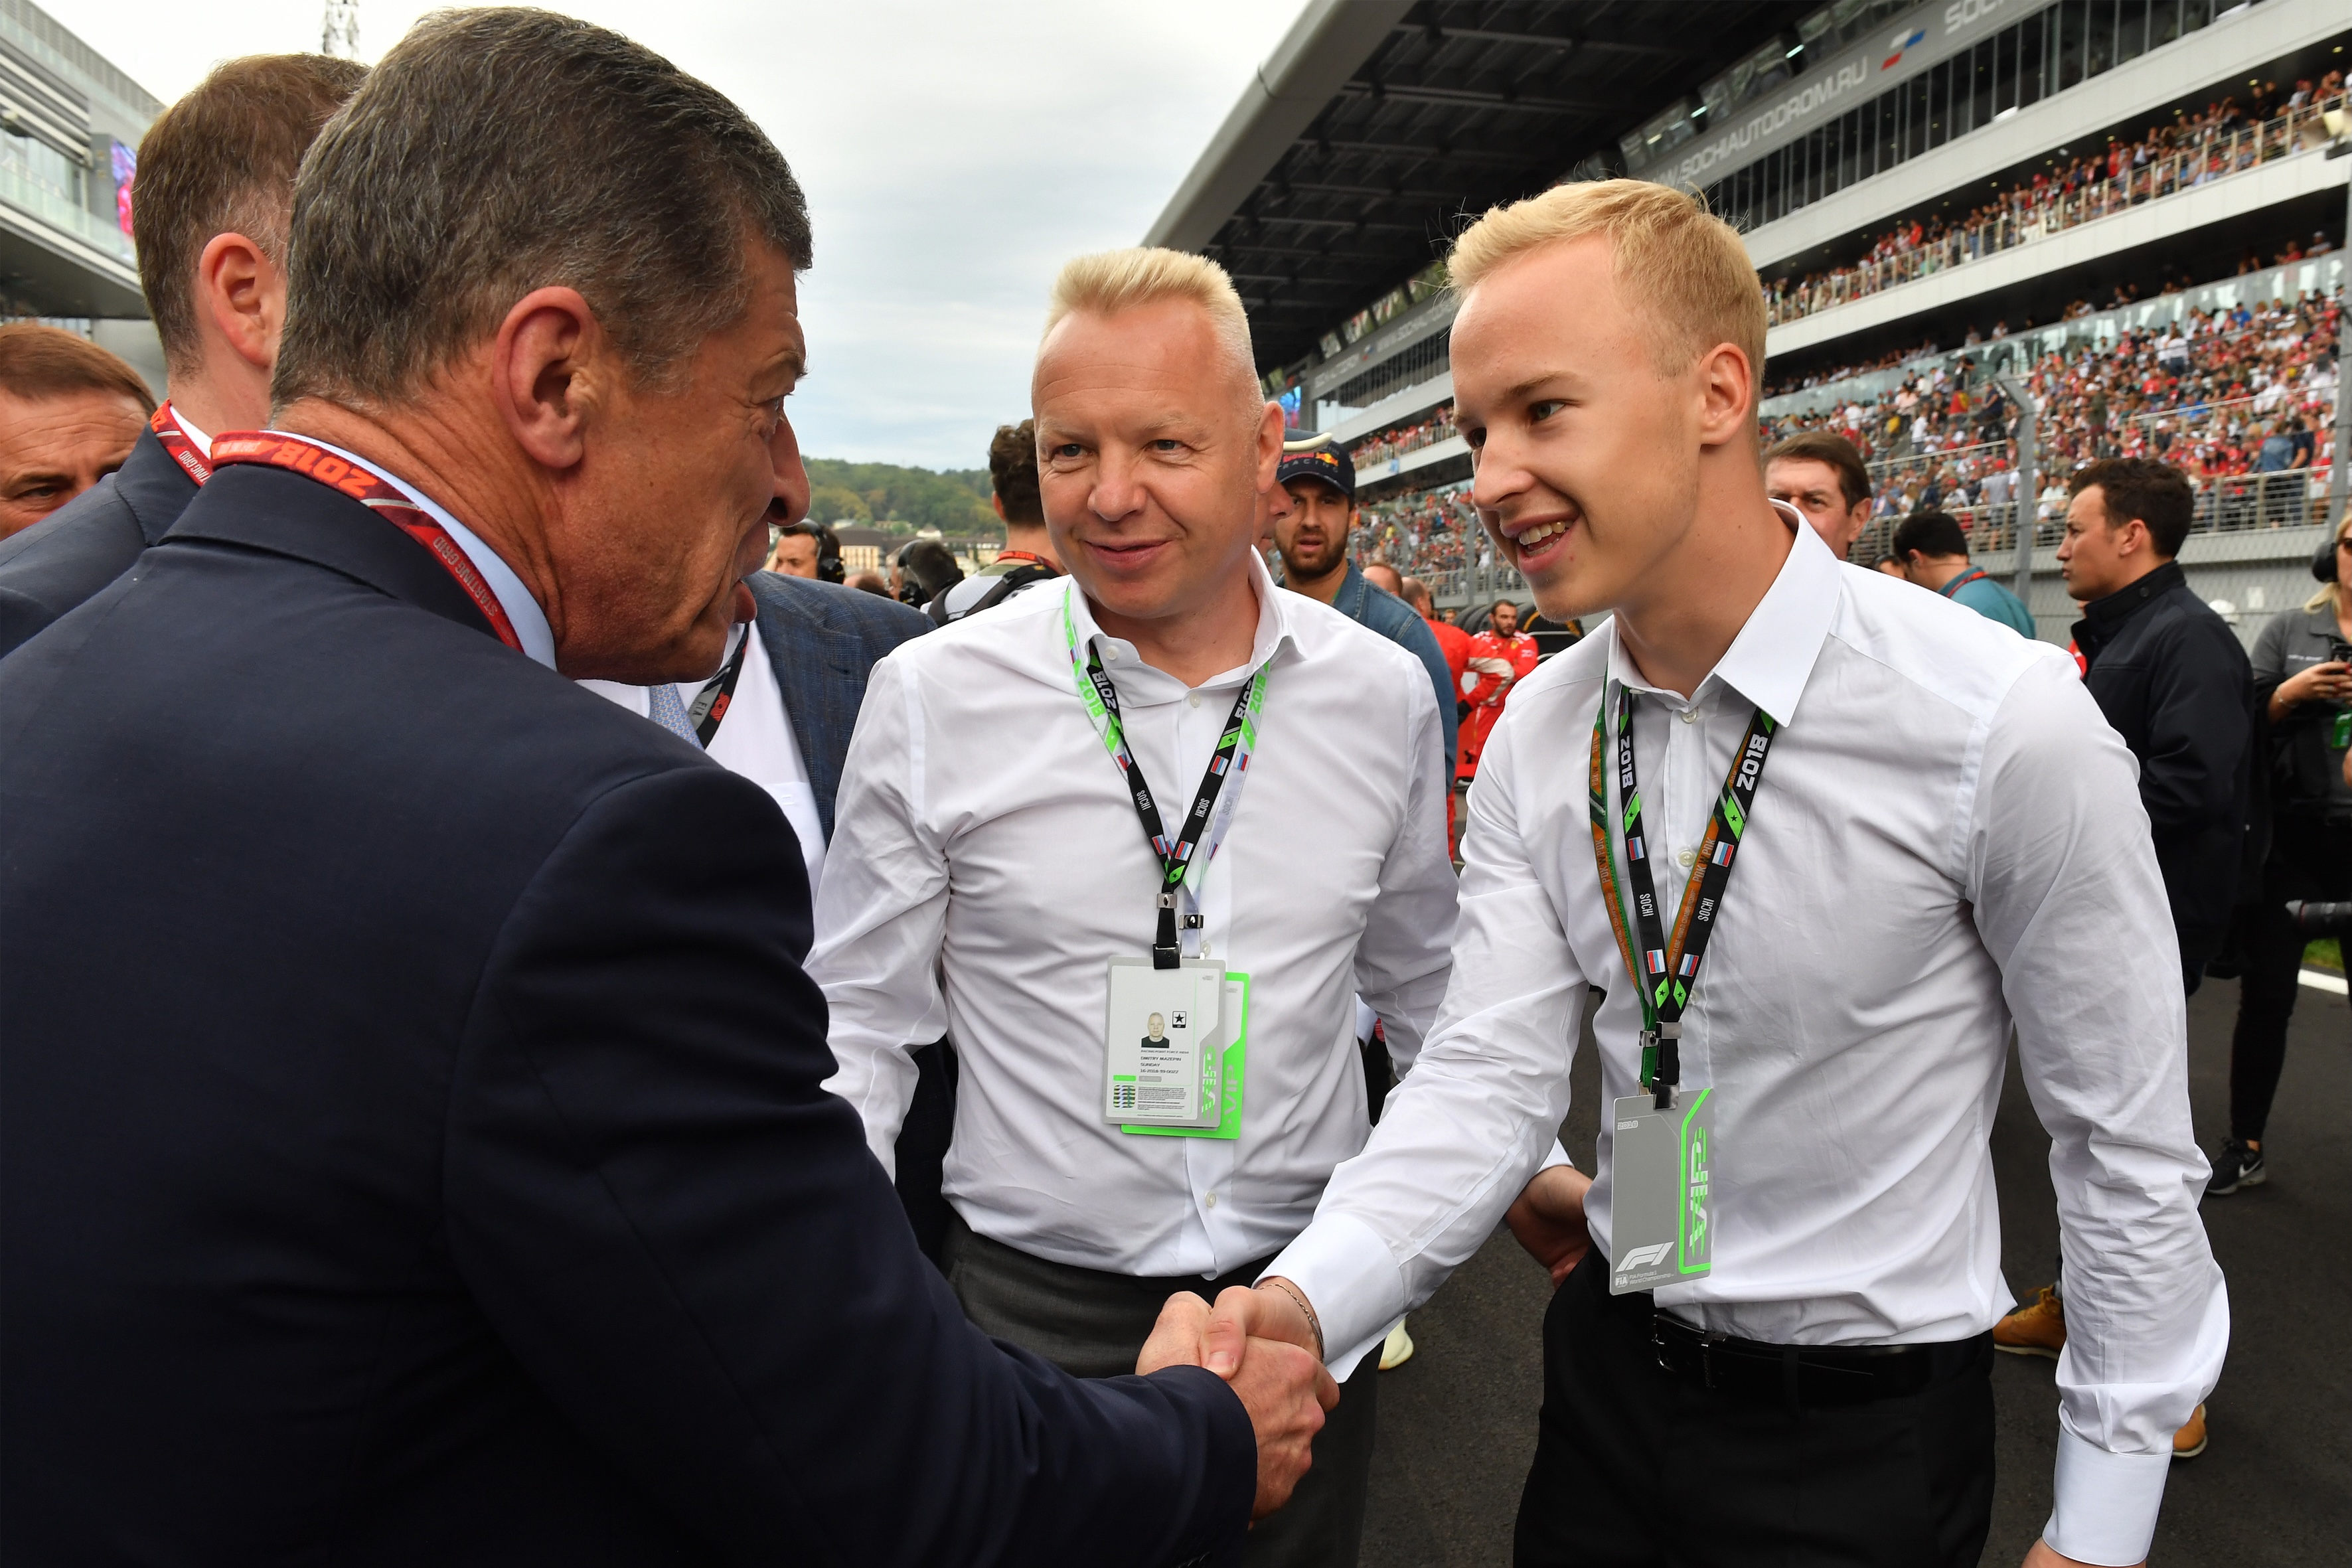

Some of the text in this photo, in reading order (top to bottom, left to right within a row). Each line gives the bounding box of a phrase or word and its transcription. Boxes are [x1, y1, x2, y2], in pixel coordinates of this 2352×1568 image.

[178, 450, 198, 468] GRID
[271, 441, 378, 498] 2018
[433, 536, 498, 617] STARTING GRID
[1077, 675, 1107, 718] 2018
[1091, 670, 1117, 710] 2018
[1249, 673, 1267, 715] 2018
[1620, 735, 1634, 789] 2018
[1735, 733, 1768, 791] 2018
[1136, 789, 1152, 811] SOCHI
[1194, 797, 1210, 819] SOCHI
[1221, 795, 1234, 816] SOCHI
[1595, 837, 1605, 855] PDK
[1601, 867, 1610, 884] PDK
[1639, 892, 1654, 917] SOCHI
[1697, 897, 1715, 922] SOCHI
[1223, 1064, 1239, 1117] VIP
[1617, 1120, 1638, 1131] 2018
[1614, 1276, 1628, 1286] FIA
